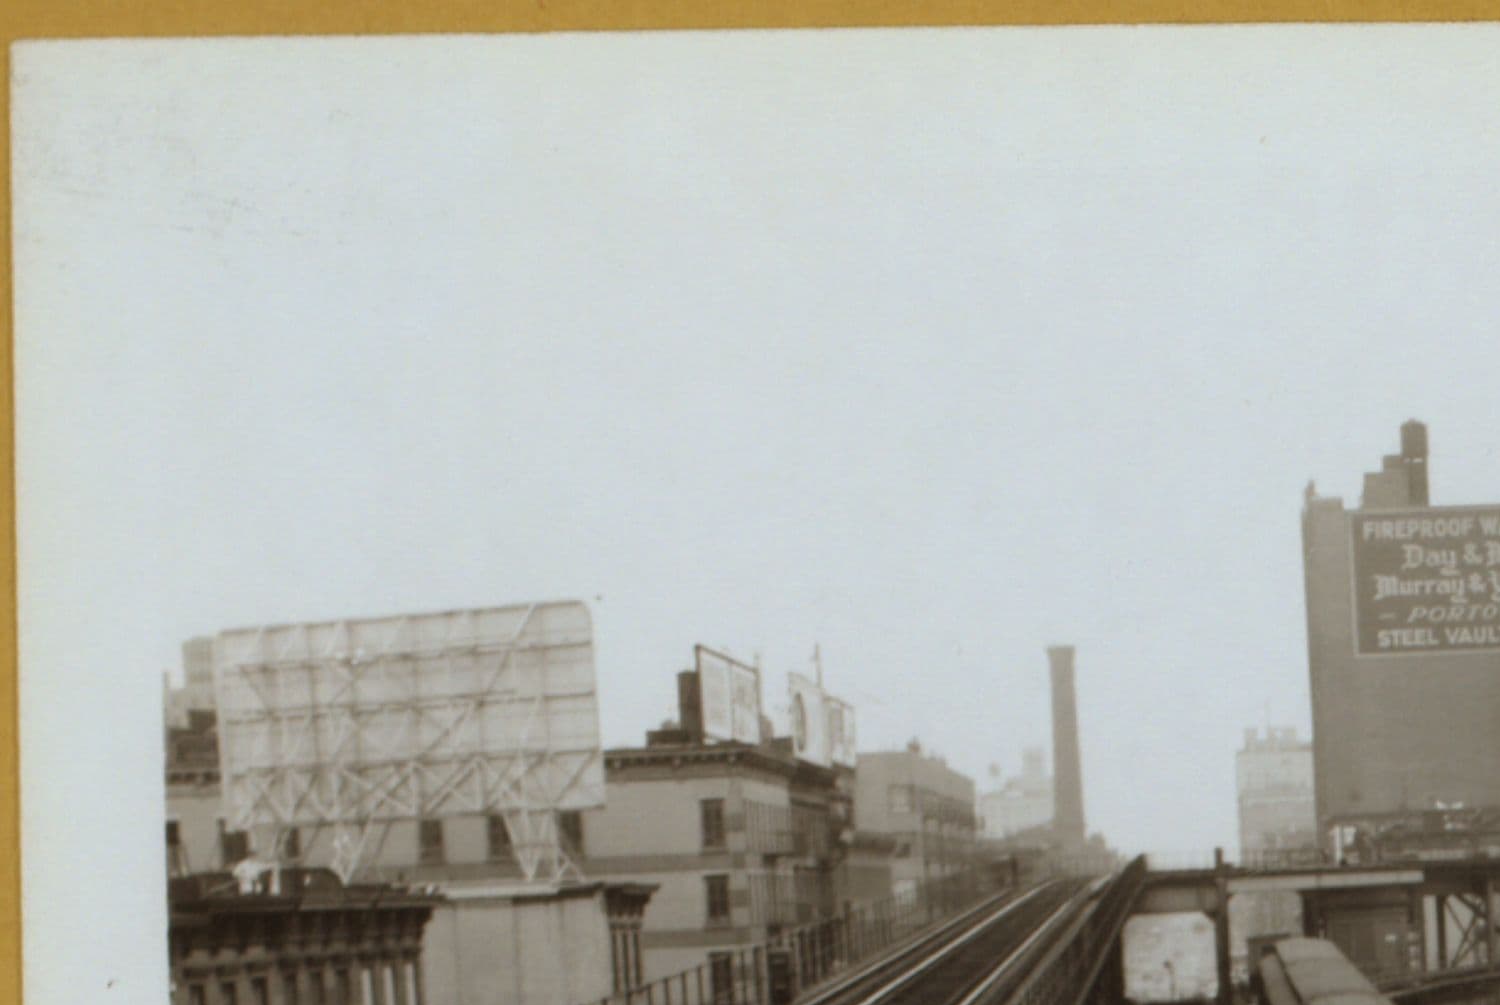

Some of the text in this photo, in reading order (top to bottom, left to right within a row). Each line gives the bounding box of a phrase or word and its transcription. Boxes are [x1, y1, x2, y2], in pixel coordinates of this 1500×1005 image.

[1363, 517, 1474, 541] FIREPROOF
[1401, 543, 1460, 577] Day
[1463, 542, 1483, 566] &
[1374, 574, 1467, 604] Murray
[1468, 571, 1487, 594] &
[1377, 628, 1440, 649] STEEL
